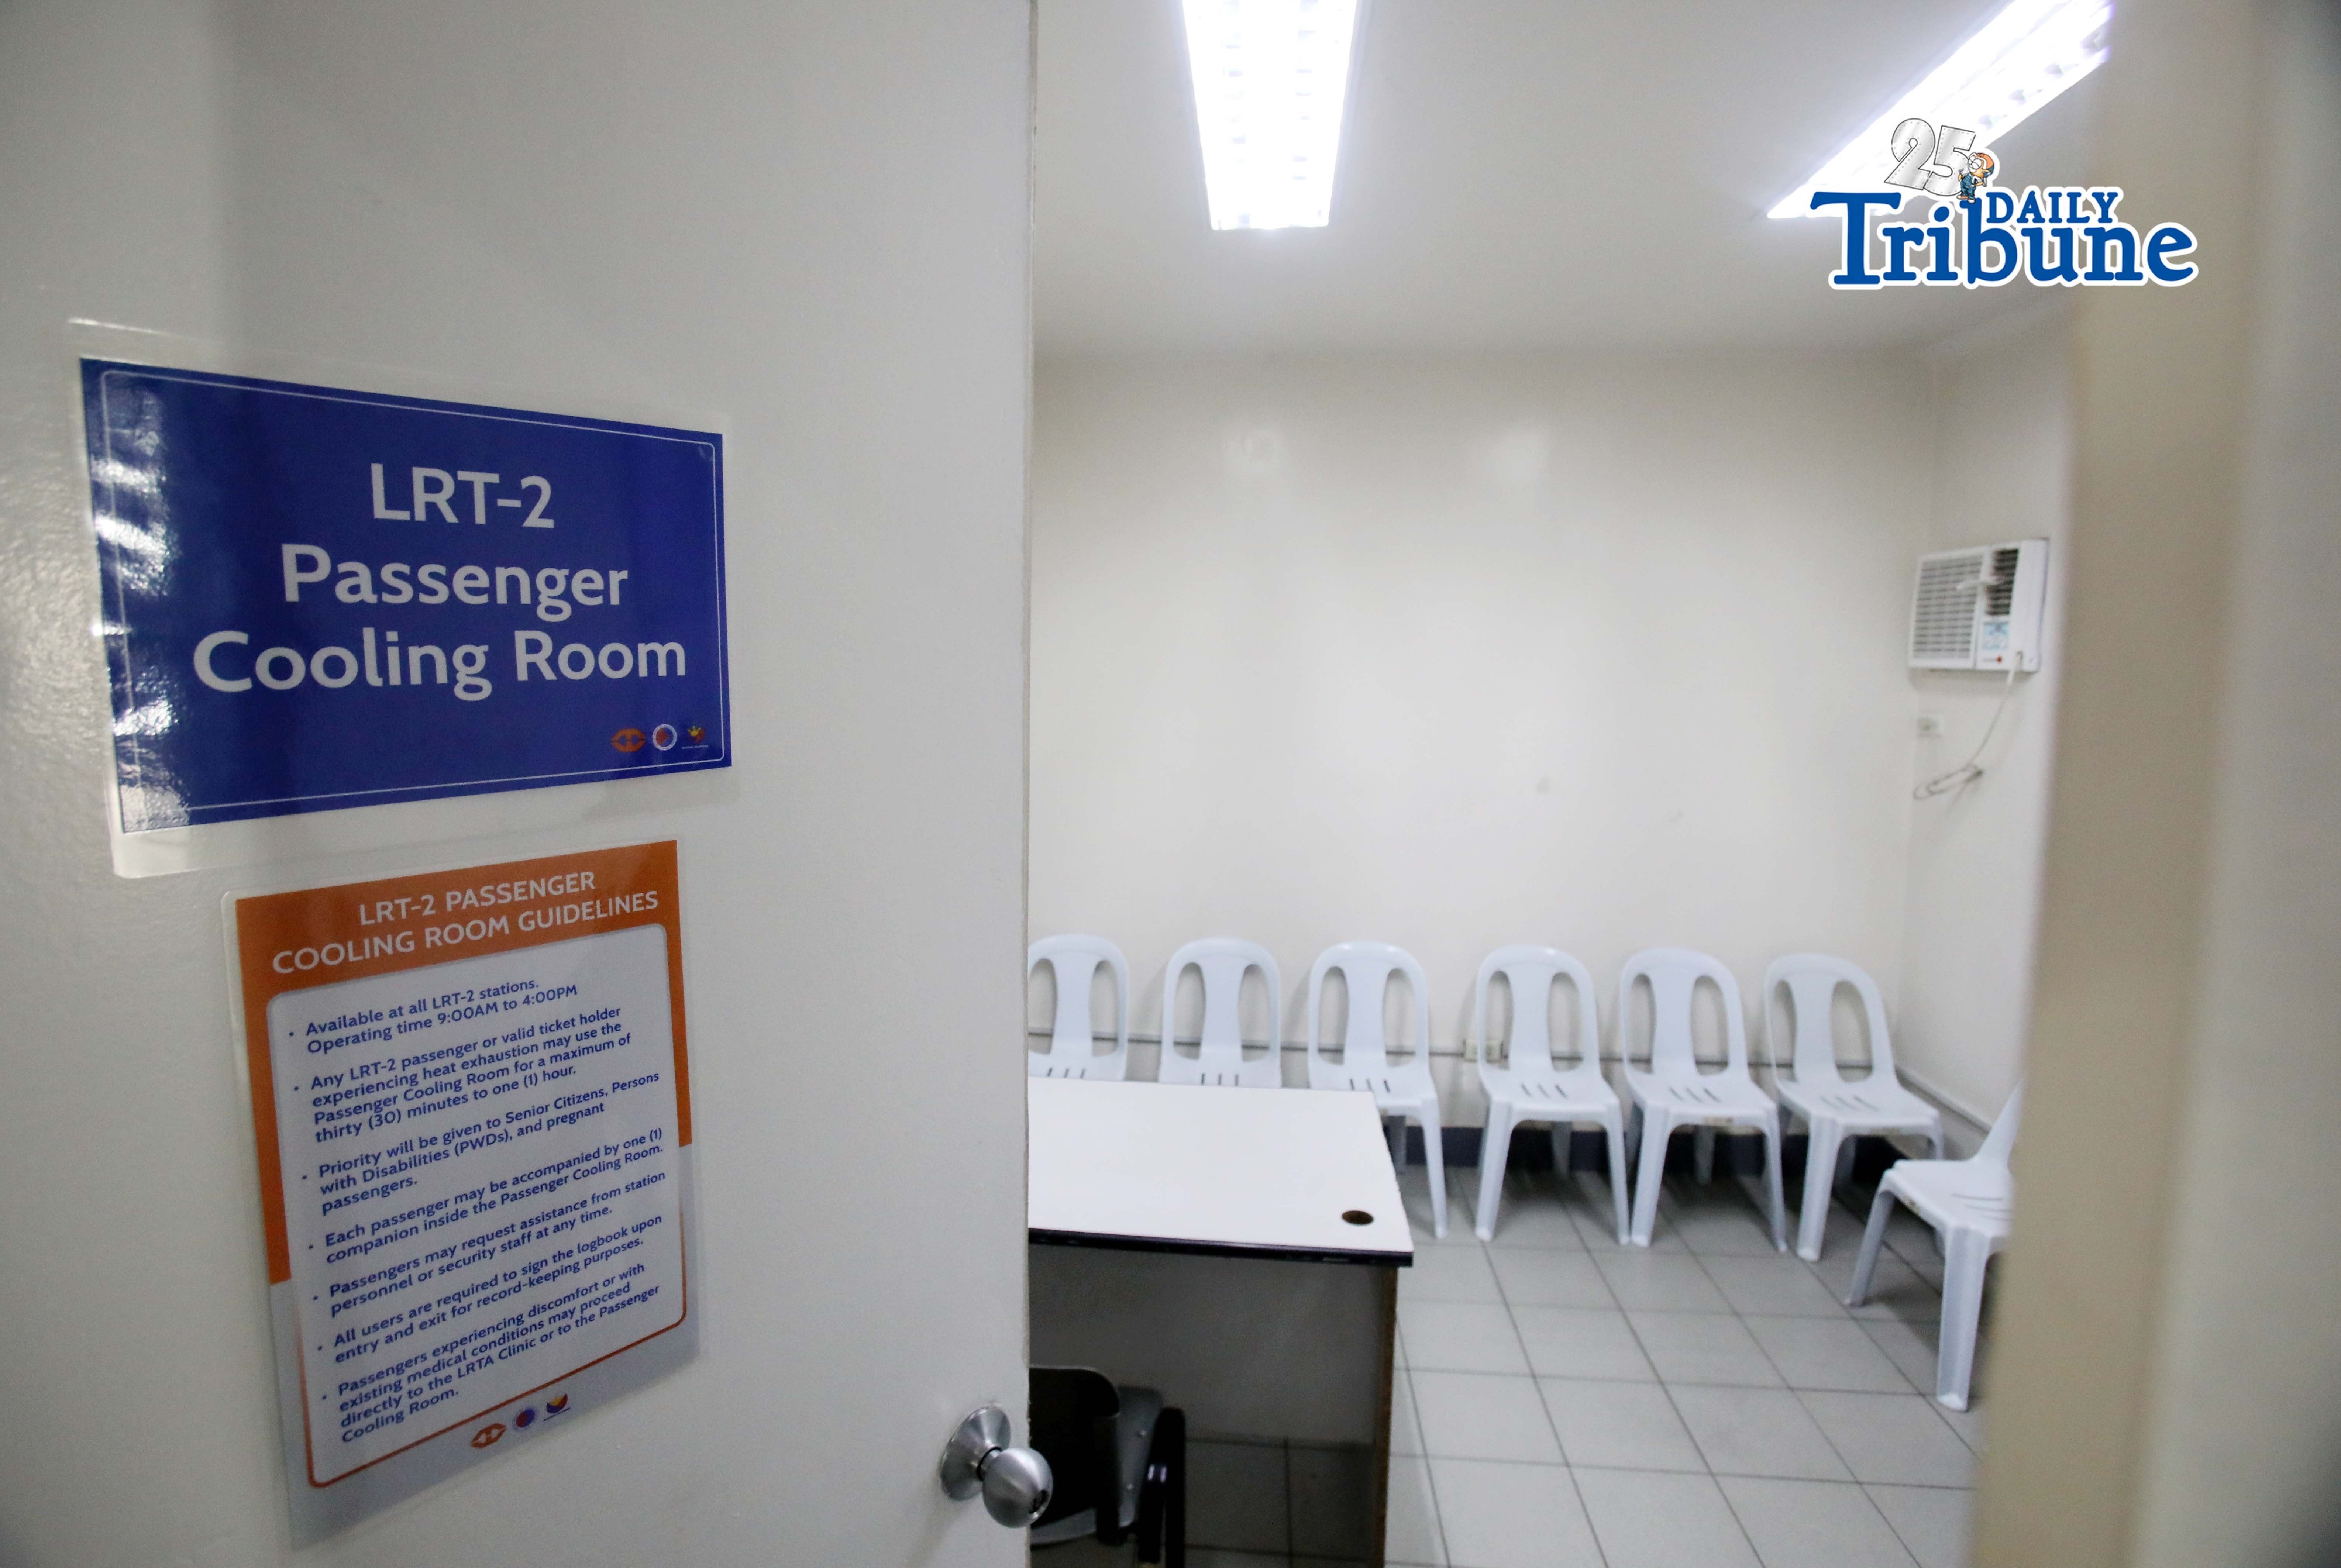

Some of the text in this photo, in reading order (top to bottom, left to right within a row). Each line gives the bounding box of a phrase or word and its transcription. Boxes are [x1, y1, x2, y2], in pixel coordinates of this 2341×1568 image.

[371, 463, 554, 528] LRT-2
[282, 544, 629, 623] Passenger
[193, 627, 686, 702] Cooling Room
[272, 890, 659, 974] COOLING ROOM GUIDELINES
[359, 870, 596, 926] LRT-2 PASSENGER
[306, 980, 539, 1036] Available at all LRT-2 stations.
[307, 984, 578, 1055] Operating time 9:00AM to 4:00PM
[311, 1008, 620, 1090] Any LRT-2 passenger or valid ticket holder
[312, 1023, 622, 1107] experiencing heat exhaustion may use the
[314, 1032, 631, 1125] Passenger Cooling Room for a maximum of
[315, 1066, 576, 1143] thirty (30) minutes to one (1) hour.
[319, 1073, 660, 1178] Priority will be given to Senior Citizens, Persons
[320, 1103, 605, 1195] with Disabilities (PWDs), and pregnant
[322, 1177, 417, 1217] passengers.
[325, 1127, 662, 1247] Each passenger may be accompanied by one (1)
[326, 1145, 663, 1264] companion inside the Passenger Cooling Room.
[330, 1172, 665, 1297] Passengers may request assistance from station
[331, 1207, 612, 1318] personnel or security staff at any time.
[334, 1216, 662, 1347] All users are required to sign the logbook upon
[335, 1238, 643, 1363] entry and exit for record-keeping purposes.
[338, 1263, 644, 1396] Passengers experiencing discomfort or with
[340, 1281, 630, 1412] existing medical conditions may proceed
[340, 1286, 659, 1427] directly to the LRTA Clinic or to the Passenger
[342, 1389, 458, 1443] Cooling Room.
